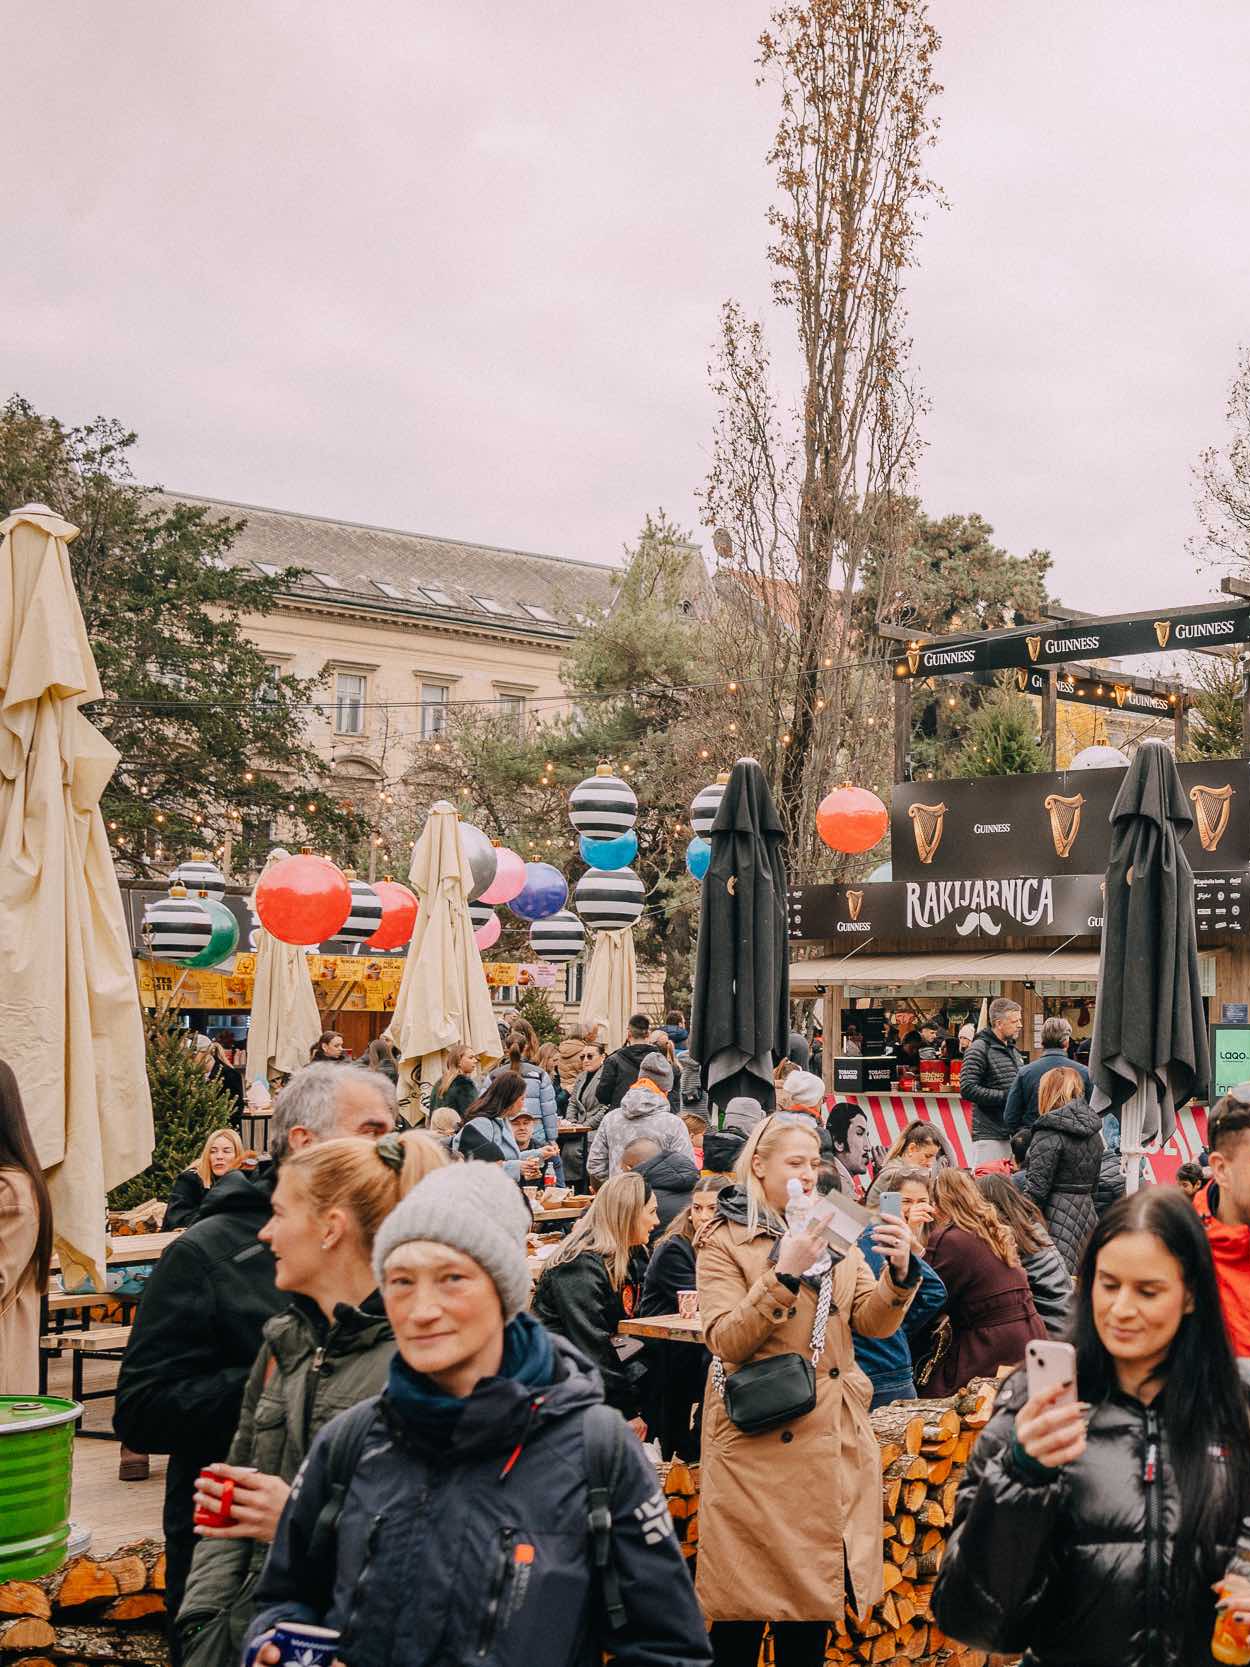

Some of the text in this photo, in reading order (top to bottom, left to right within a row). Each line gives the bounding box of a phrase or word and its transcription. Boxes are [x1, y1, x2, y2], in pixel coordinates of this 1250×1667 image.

[1175, 620, 1235, 639] GUINNESS
[1045, 636, 1100, 654] GUINNESS
[924, 649, 976, 667] GUINNESS
[1128, 693, 1169, 710] GUINNESS
[974, 823, 1011, 834] GUINNESS
[906, 878, 1054, 929] RAKIJARNICA
[837, 921, 872, 932] GUINNESS
